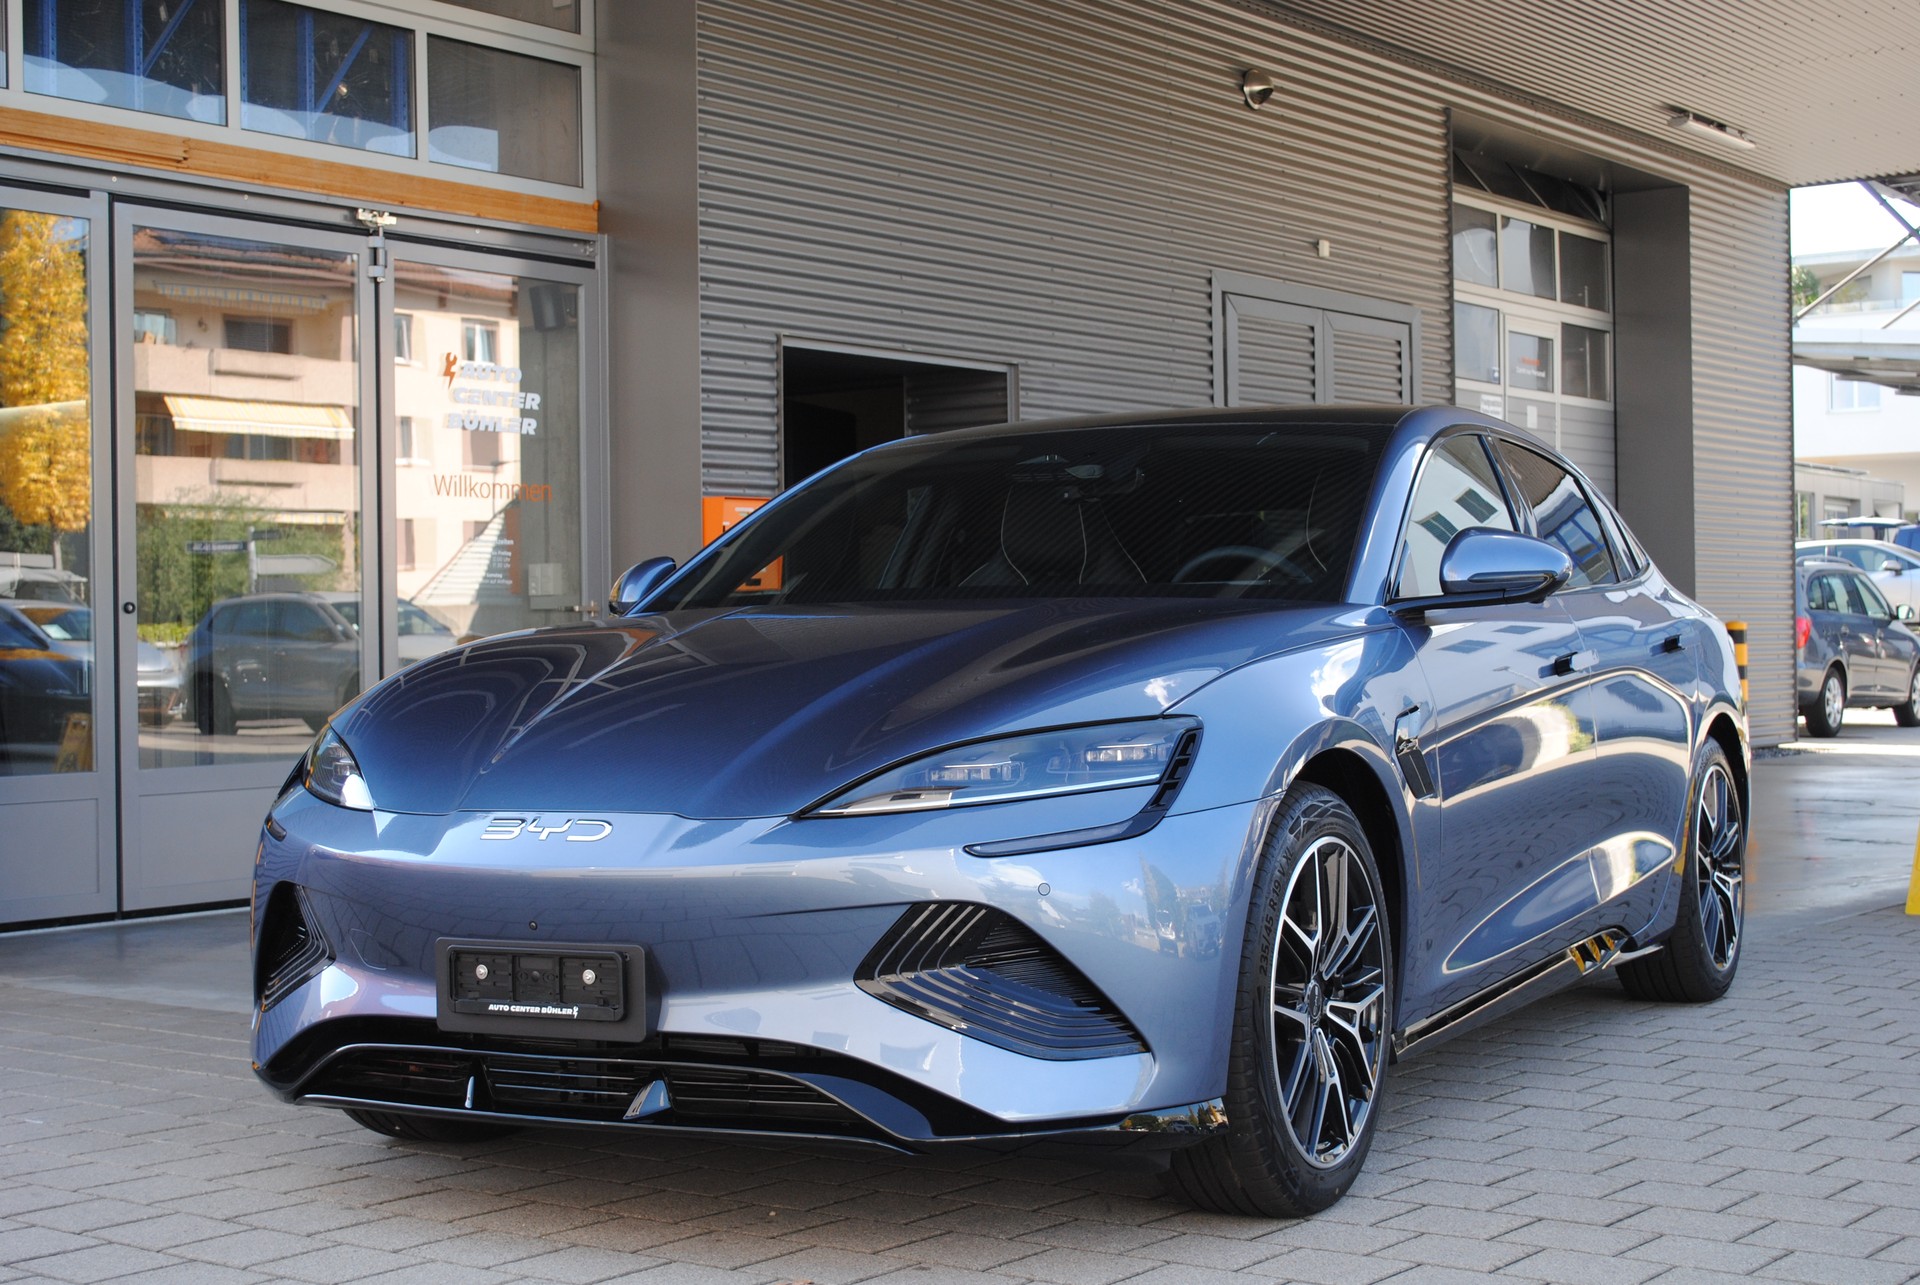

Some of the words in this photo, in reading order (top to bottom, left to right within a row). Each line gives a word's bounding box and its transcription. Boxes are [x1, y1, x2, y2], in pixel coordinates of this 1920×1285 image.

[460, 363, 522, 384] AUTO
[453, 387, 541, 410] CENTER
[447, 410, 537, 435] BÜHLER
[433, 474, 553, 502] Willkommen
[480, 816, 613, 842] BYD
[1282, 845, 1295, 862] XL
[1277, 866, 1287, 878] V
[1272, 879, 1282, 898] 19
[1268, 897, 1278, 912] R
[1259, 914, 1275, 977] 235/45
[510, 1005, 540, 1014] CENTER
[541, 1005, 573, 1015] BÜHLER
